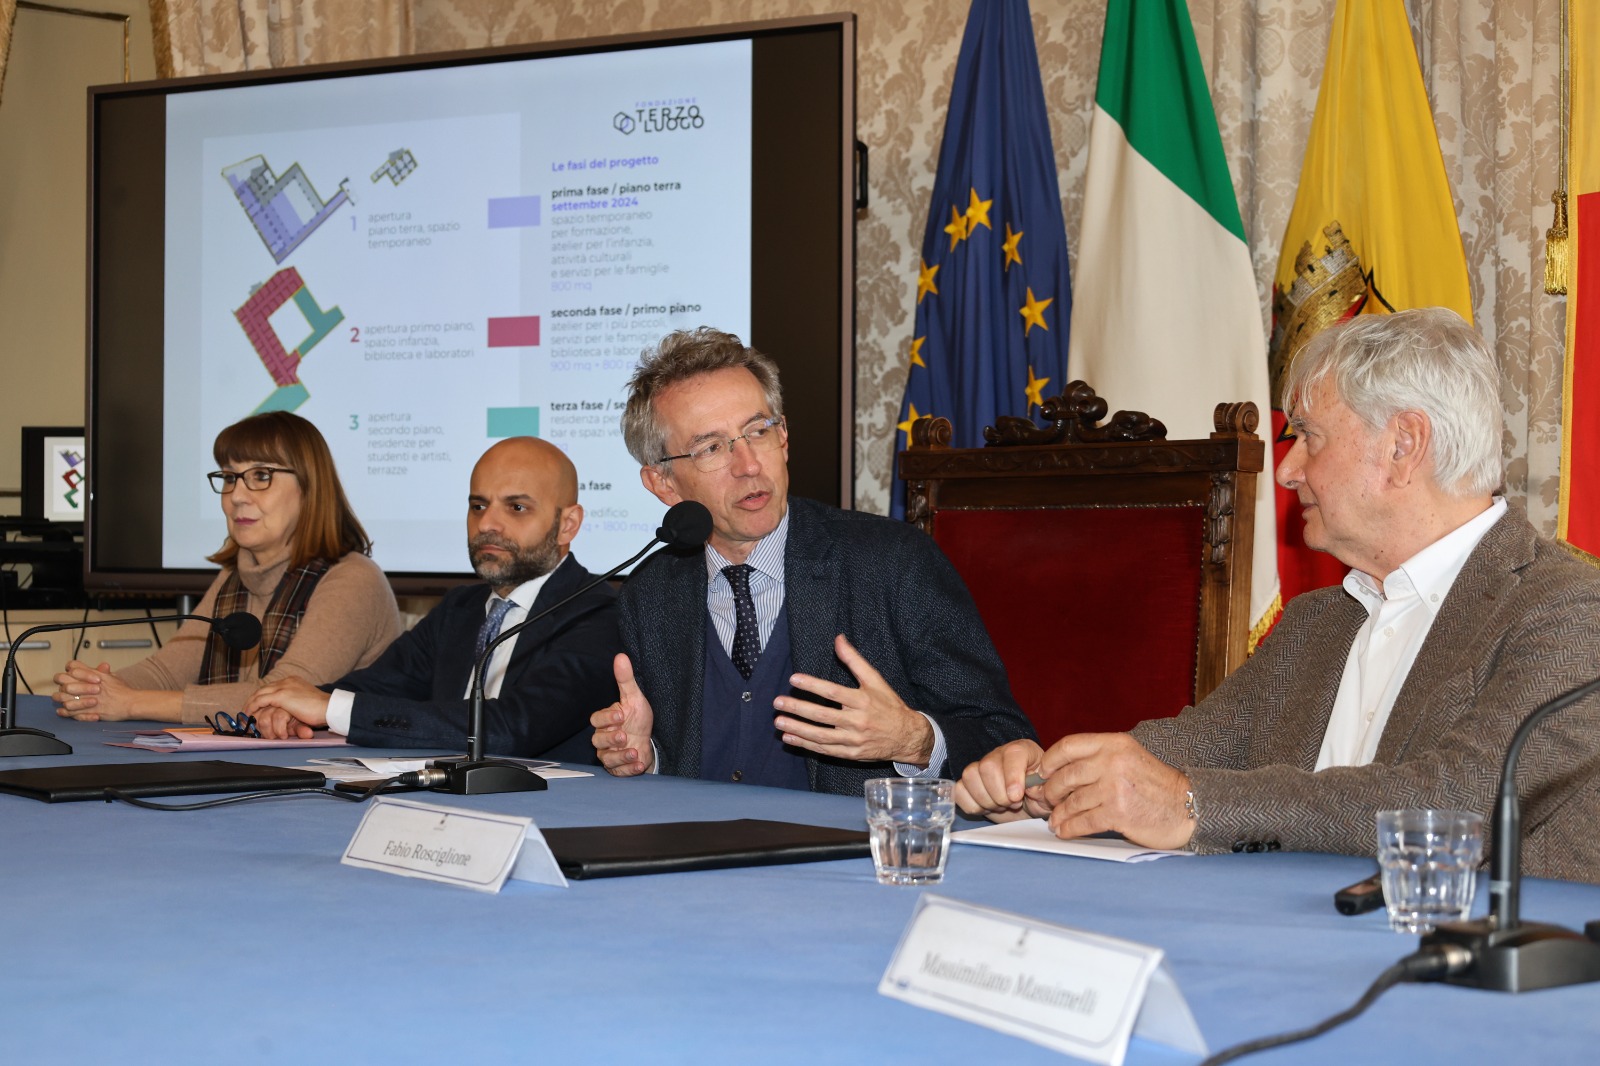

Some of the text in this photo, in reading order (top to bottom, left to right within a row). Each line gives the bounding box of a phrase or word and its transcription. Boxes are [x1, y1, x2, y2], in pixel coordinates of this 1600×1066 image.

[635, 97, 697, 108] FONDAZIONE
[636, 105, 701, 122] TERZO
[644, 115, 705, 133] LUOGO
[552, 156, 659, 172] Le fasi del progetto
[552, 181, 681, 199] prima fase / piano terra
[552, 197, 639, 211] settembre 2024
[351, 212, 412, 231] 1 apertura
[551, 210, 653, 225] spazio temporaneo
[368, 221, 461, 237] piano terra, spazio
[551, 225, 633, 239] per formazione,
[368, 237, 432, 250] temporaneo
[551, 241, 583, 252] atelier
[586, 240, 603, 251] per
[551, 251, 632, 265] attività culturali
[551, 263, 669, 278] e servizi per le famiglie
[551, 281, 592, 292] 800 mq
[551, 303, 701, 318] seconda fase / primo piano
[551, 320, 583, 331] atelier
[585, 321, 603, 331] per
[611, 318, 629, 329] più
[350, 321, 475, 343] 2 apertura primo piano,
[551, 331, 660, 345] servizi per le famiglie
[364, 335, 440, 348] spazio infanzia,
[364, 349, 474, 361] biblioteca e laboratori
[551, 346, 601, 358] biblioteca
[604, 348, 610, 356] e
[551, 361, 571, 371] 900
[573, 362, 591, 372] mq
[551, 401, 578, 411] terza
[581, 400, 603, 410] fase
[605, 398, 612, 411] /
[349, 412, 412, 431] 3 apertura
[550, 413, 600, 424] residenza
[368, 425, 445, 436] secondo piano,
[550, 427, 567, 438] bar
[570, 429, 577, 437] e
[579, 427, 605, 439] spazi
[368, 438, 435, 449] residenze per
[367, 451, 451, 463] studenti e artisti,
[367, 465, 408, 475] terrazze
[589, 480, 612, 491] fase
[590, 507, 629, 518] edificio
[383, 840, 471, 867] Fabio Rosciglione
[919, 950, 1013, 995] Massimiliano
